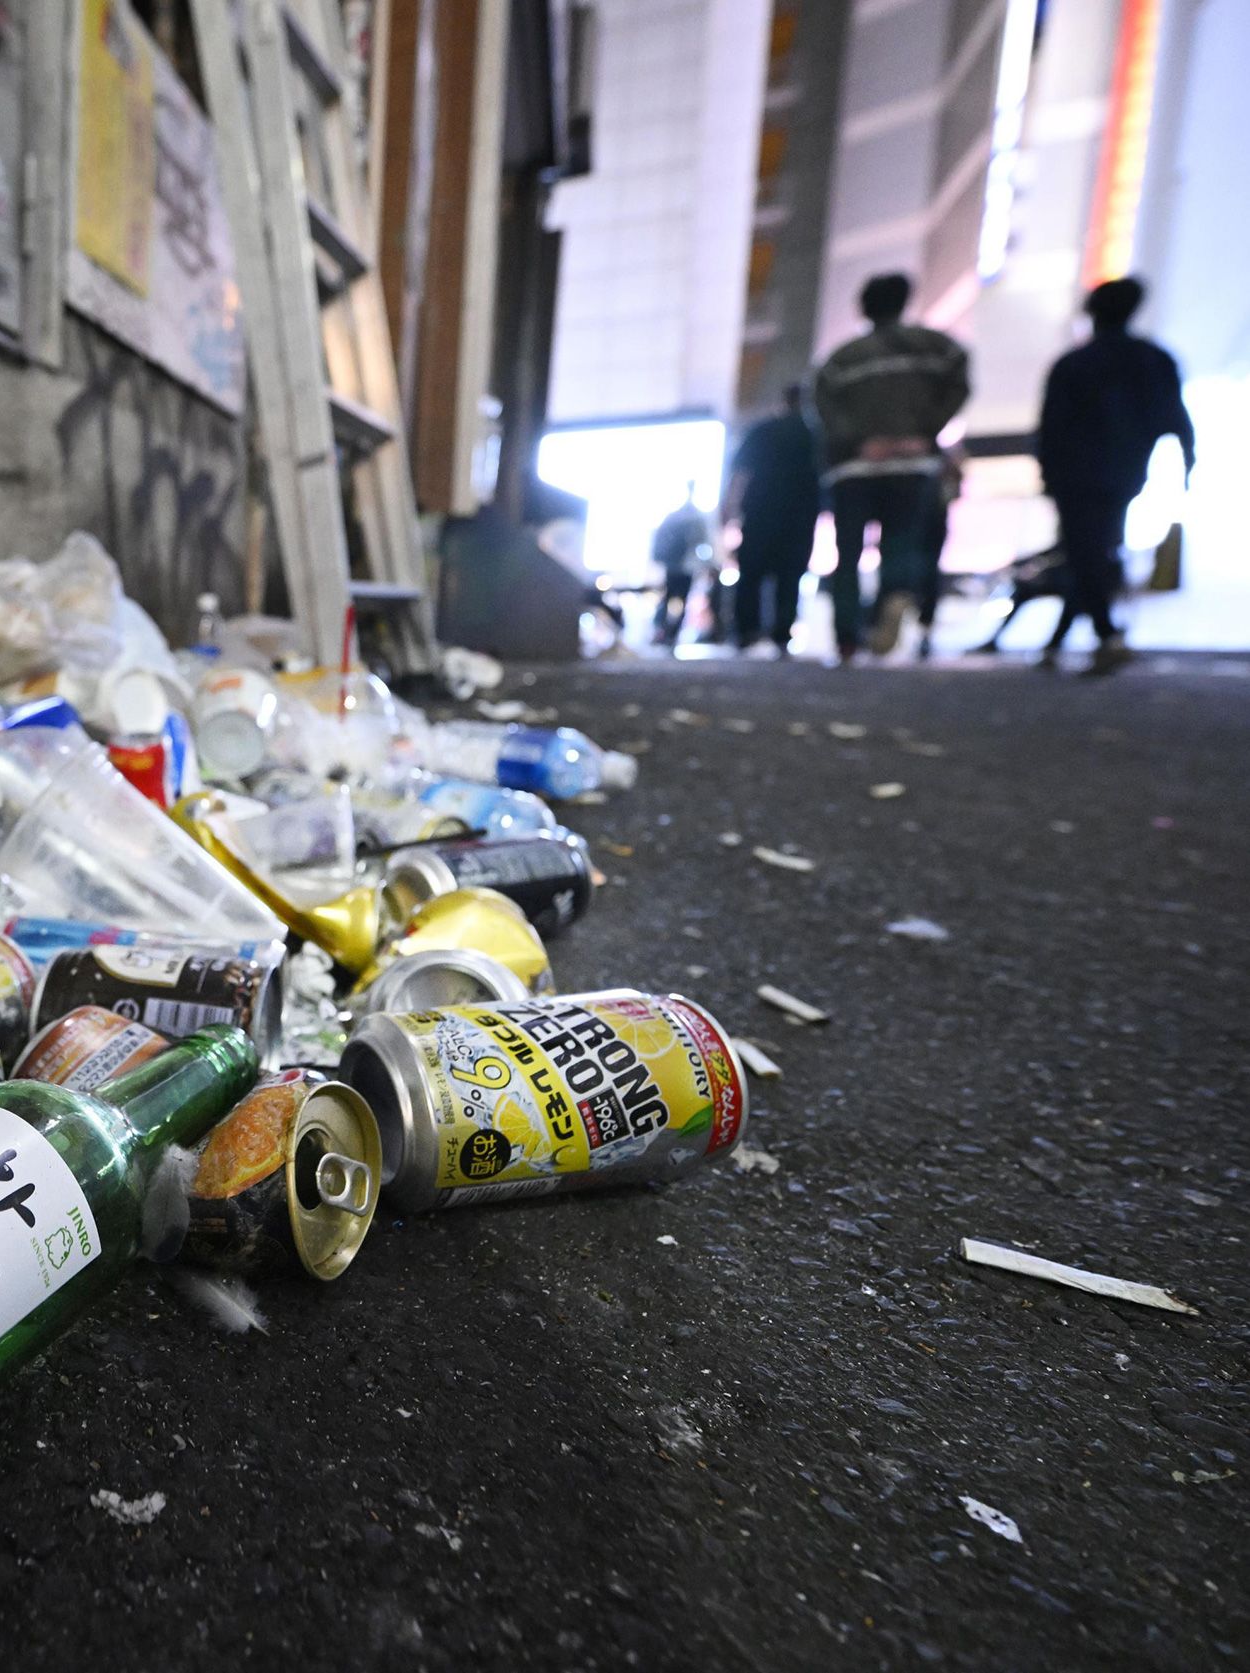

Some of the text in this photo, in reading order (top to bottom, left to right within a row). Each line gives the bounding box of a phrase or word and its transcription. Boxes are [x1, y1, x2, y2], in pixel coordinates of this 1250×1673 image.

[496, 1003, 604, 1094] ZERO
[469, 1133, 500, 1176] お酒
[66, 1205, 92, 1257] JINRO
